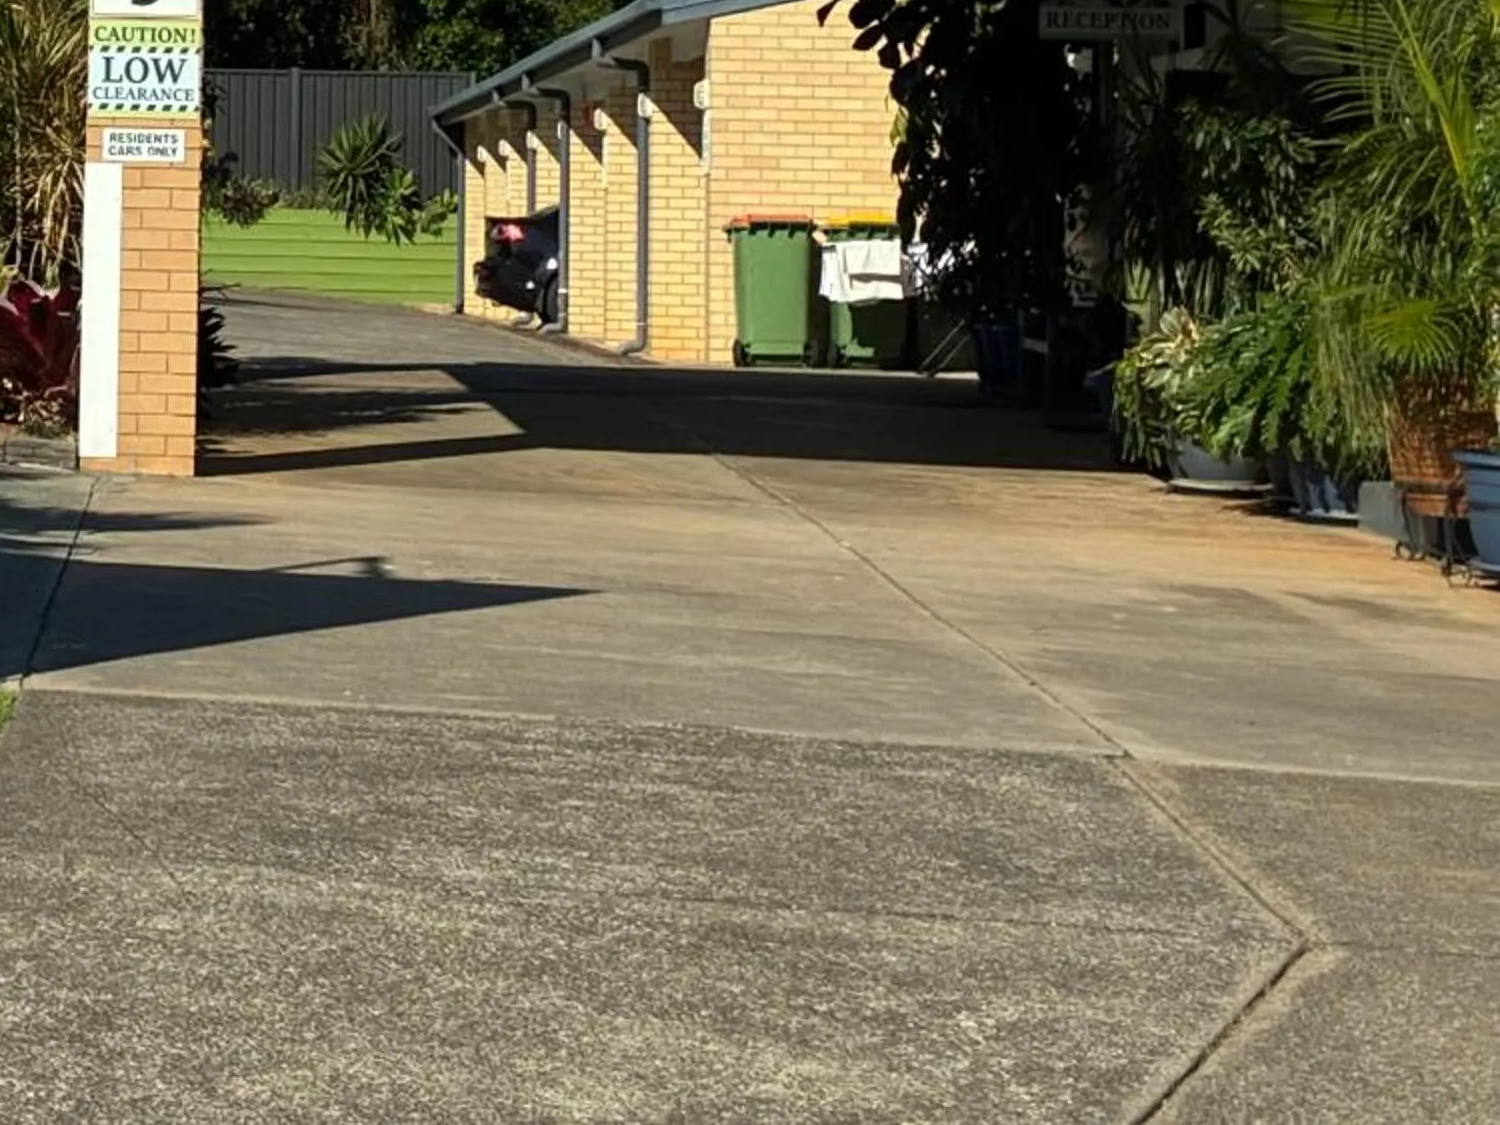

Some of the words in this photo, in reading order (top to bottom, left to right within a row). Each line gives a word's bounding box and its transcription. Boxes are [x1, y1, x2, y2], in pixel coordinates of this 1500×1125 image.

[93, 25, 197, 44] CAUTION!
[101, 55, 189, 85] LOW
[92, 85, 195, 102] CLEARANCE
[109, 132, 179, 145] RESIDENTS
[107, 145, 143, 157] CARS
[147, 146, 180, 158] ONLY
